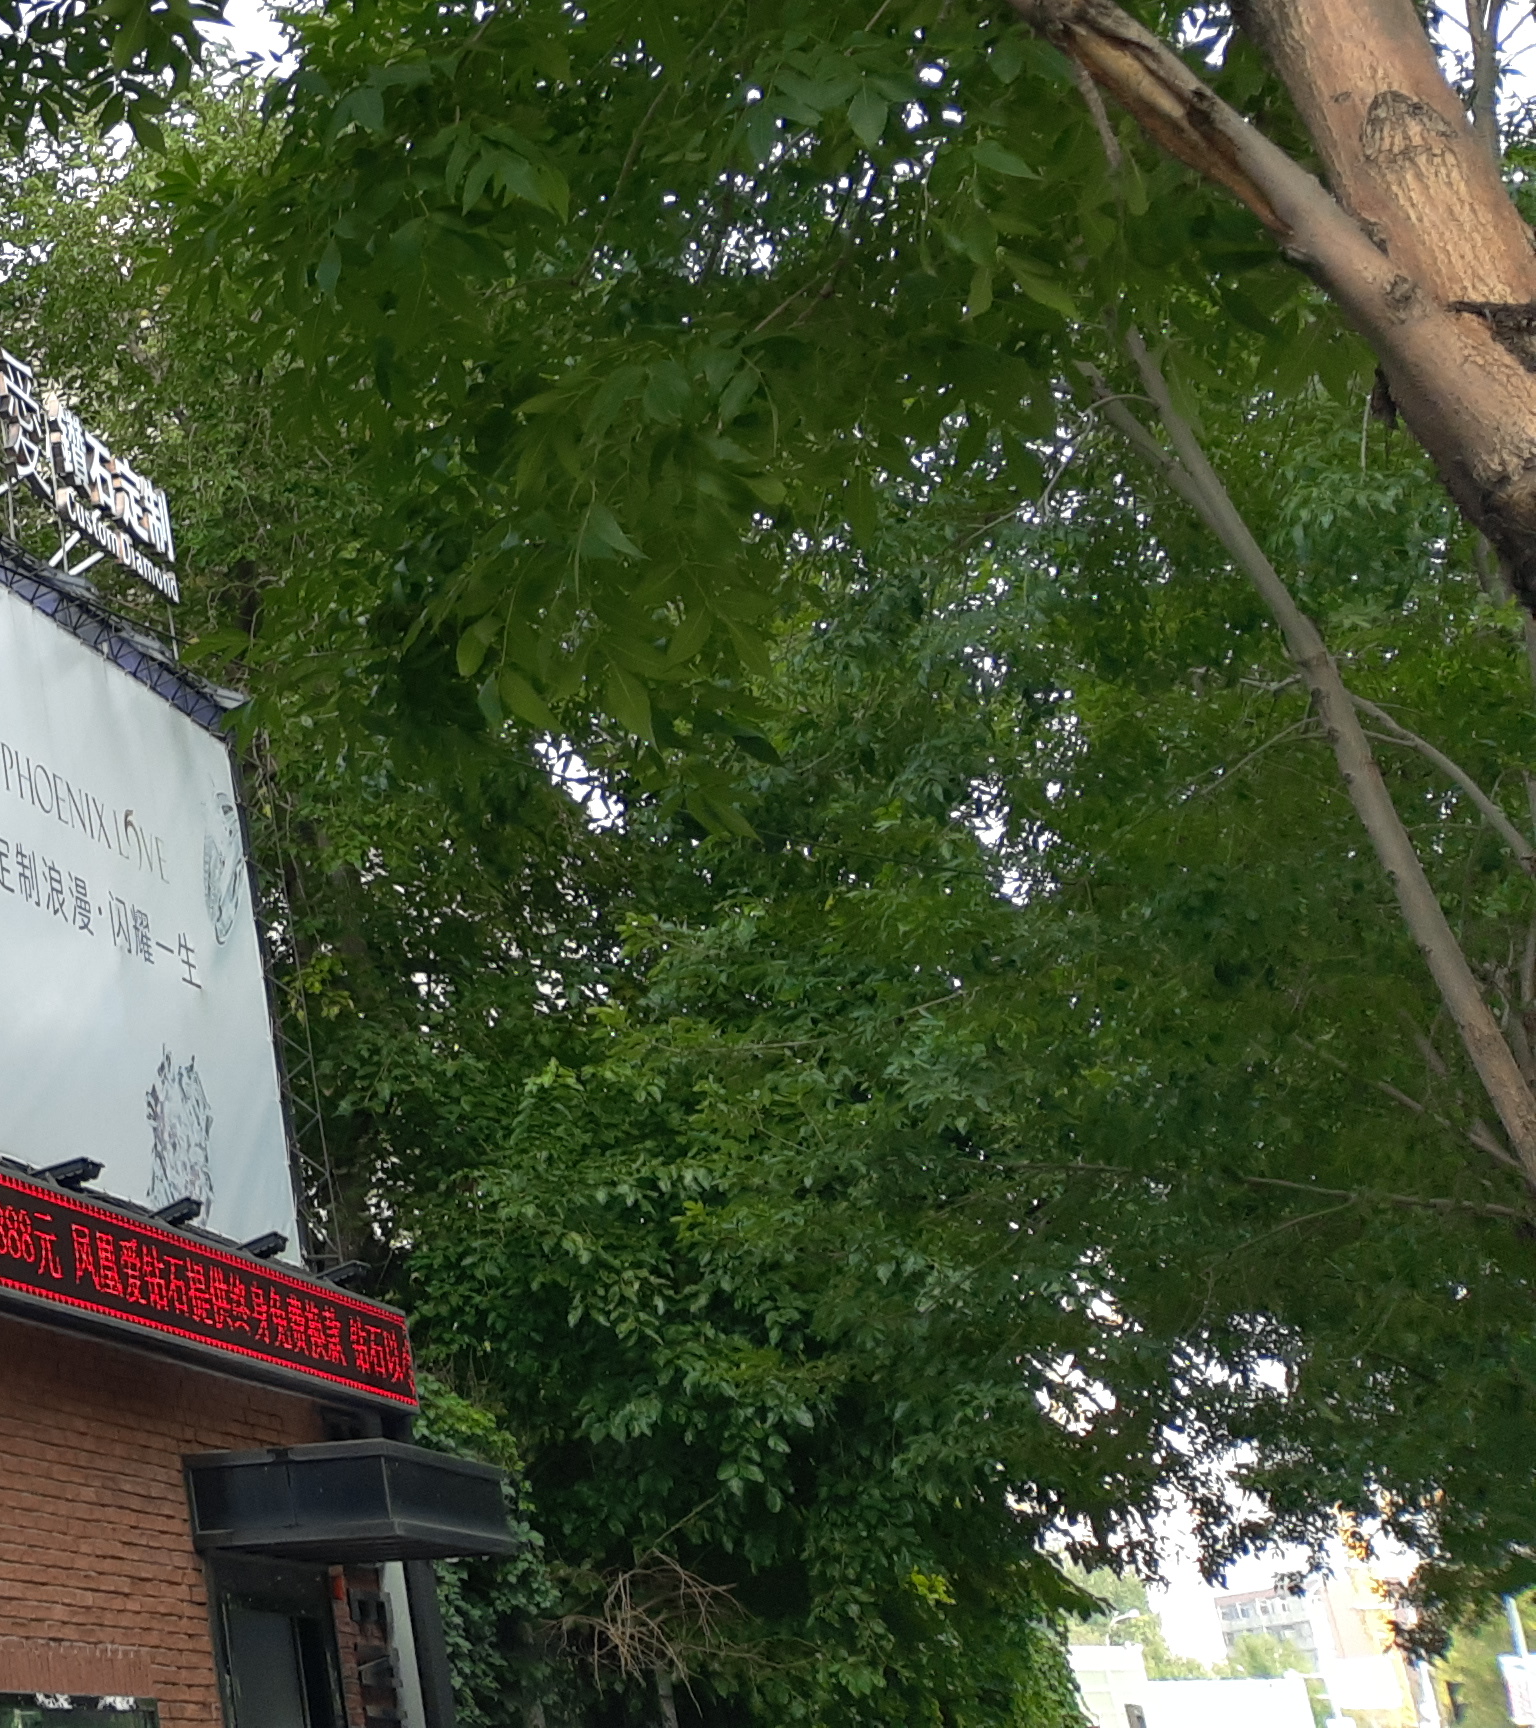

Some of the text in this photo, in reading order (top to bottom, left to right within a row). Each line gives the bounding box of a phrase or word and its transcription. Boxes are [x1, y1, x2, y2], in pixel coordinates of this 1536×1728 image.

[66, 486, 180, 604] Custom Diamond
[0, 741, 170, 885] PHOENIX LOVE
